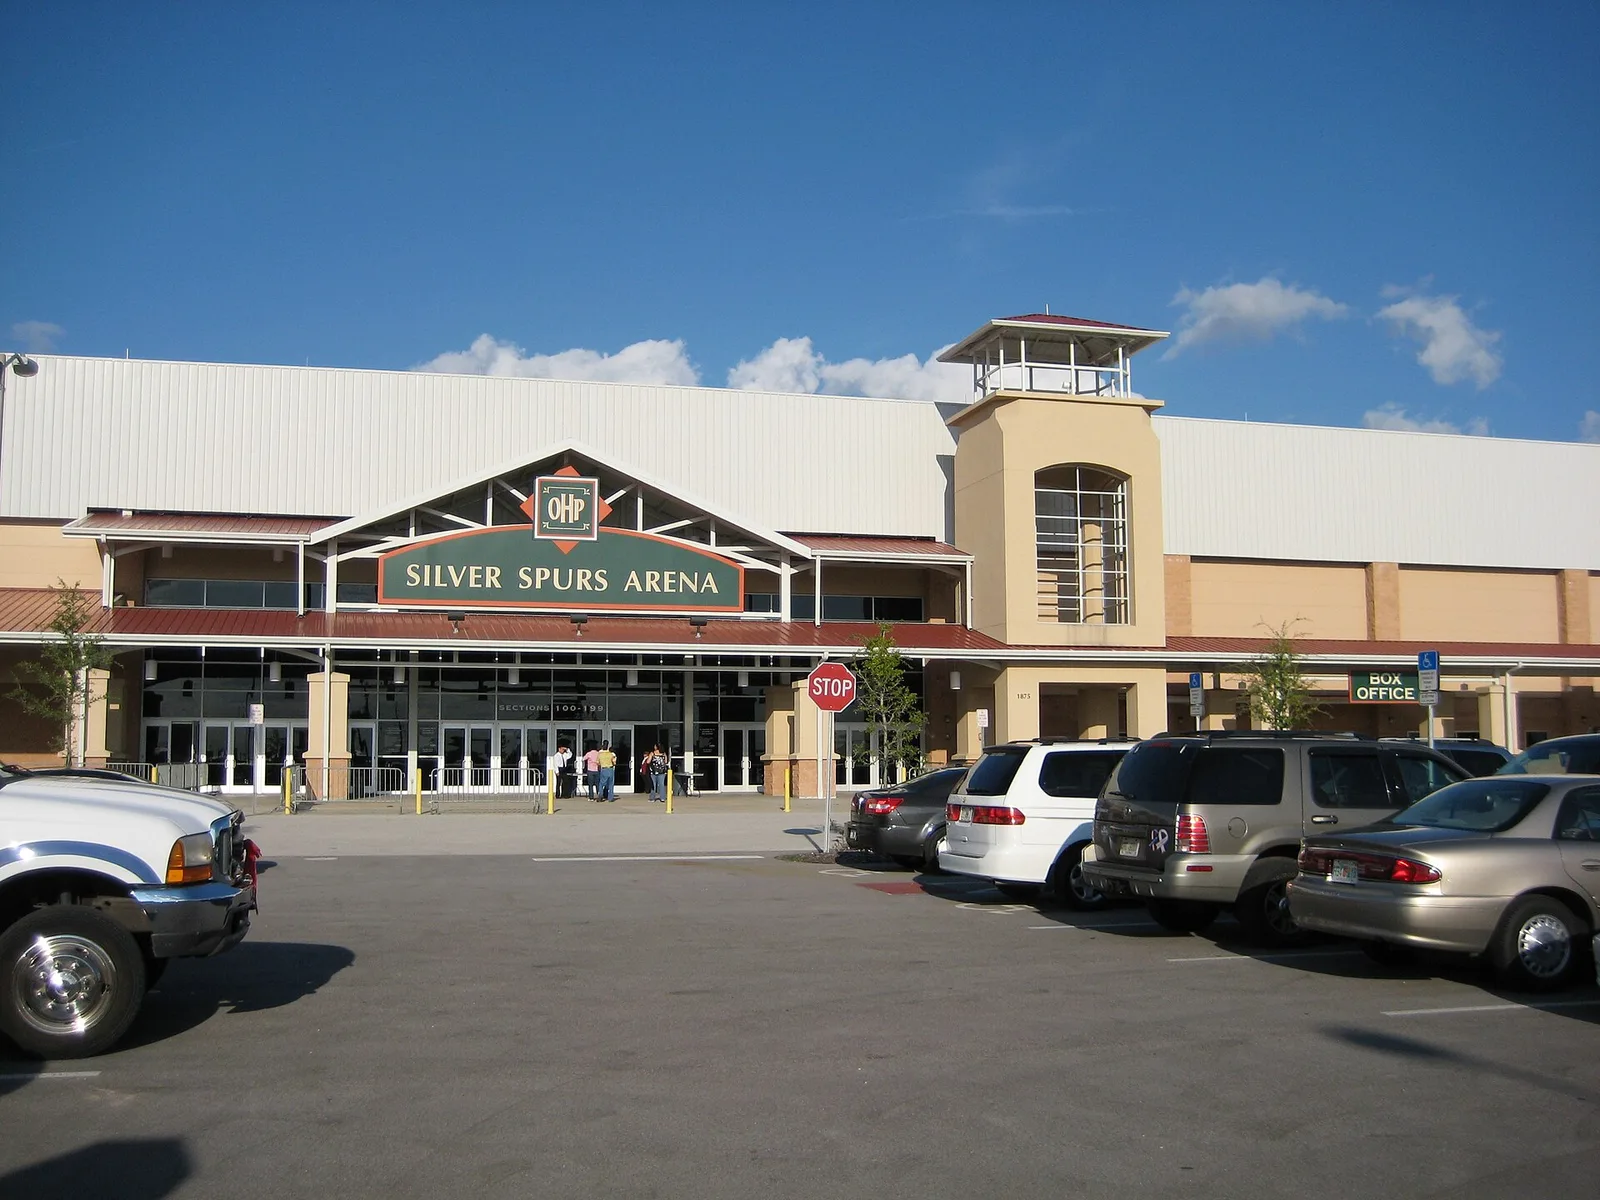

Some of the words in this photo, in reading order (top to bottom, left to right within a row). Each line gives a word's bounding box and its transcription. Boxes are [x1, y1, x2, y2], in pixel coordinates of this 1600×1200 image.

[547, 493, 586, 524] OHP
[406, 563, 502, 588] SILVER
[518, 566, 608, 592] SPURS
[623, 570, 719, 594] ARENA
[812, 677, 852, 697] STOP
[1369, 672, 1402, 685] BOX
[1356, 687, 1415, 700] OFFICE
